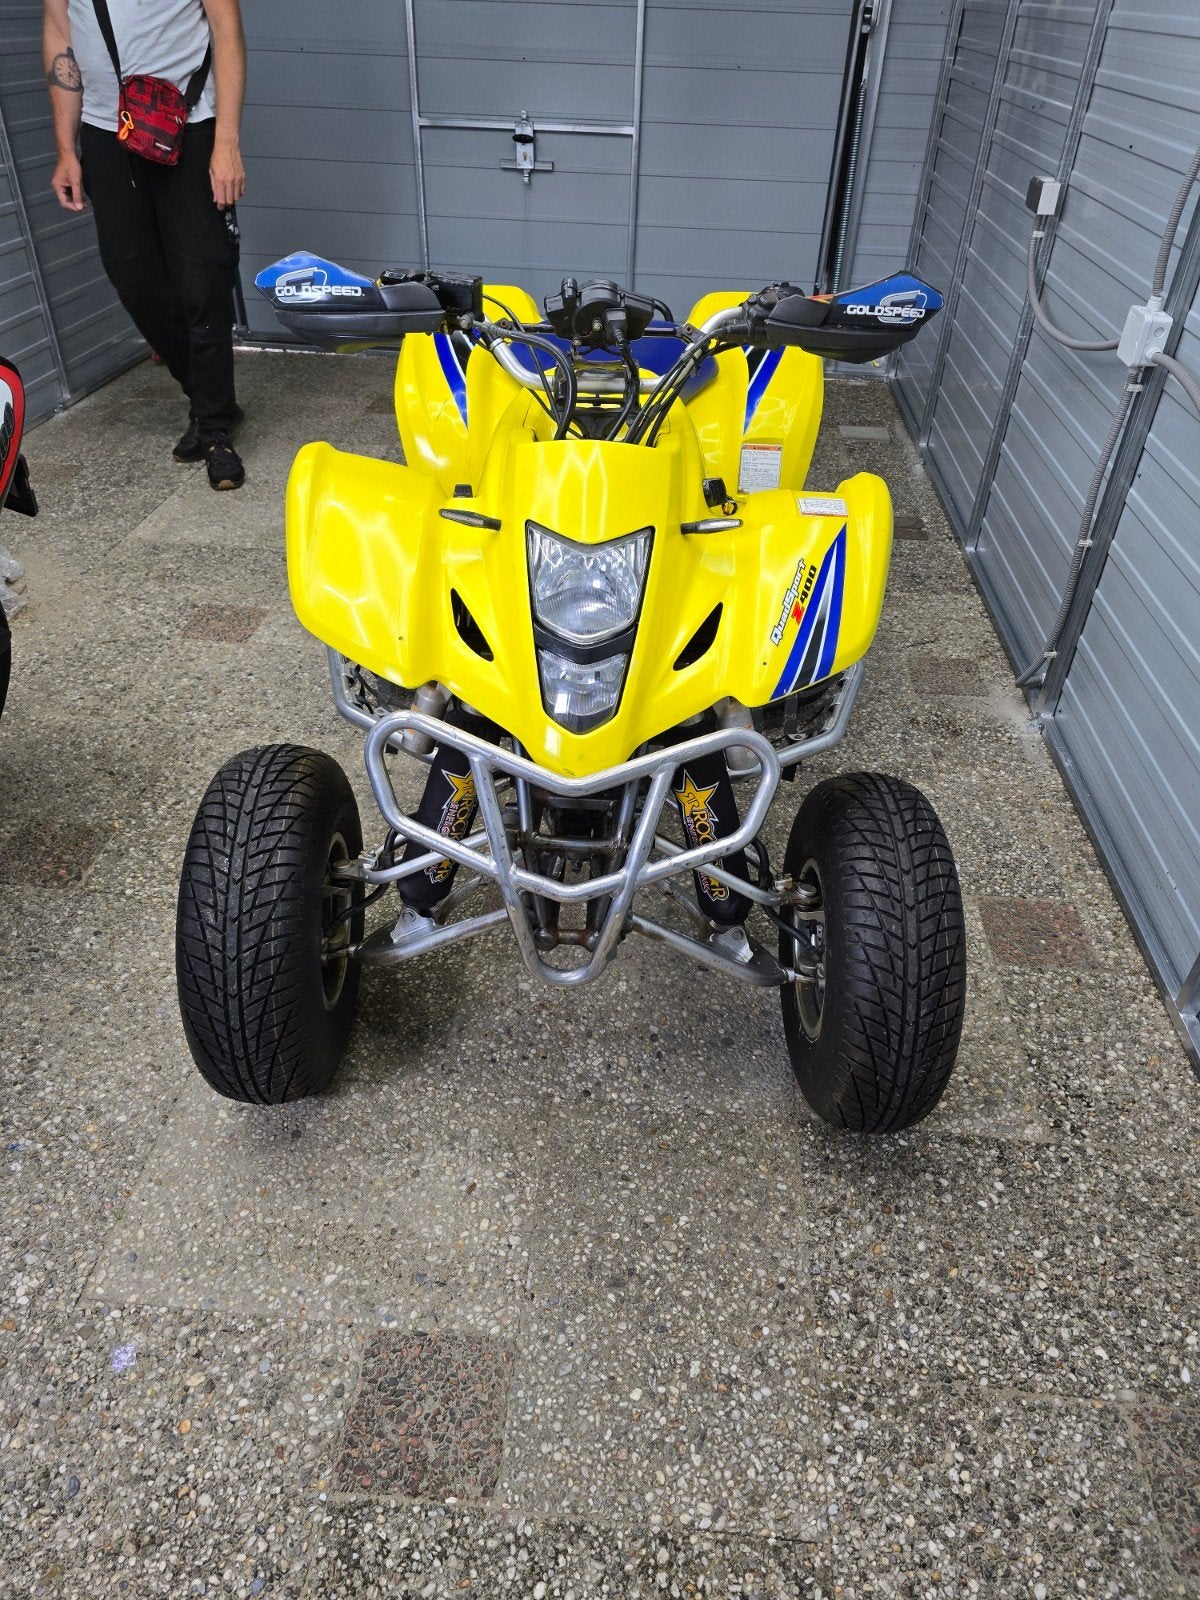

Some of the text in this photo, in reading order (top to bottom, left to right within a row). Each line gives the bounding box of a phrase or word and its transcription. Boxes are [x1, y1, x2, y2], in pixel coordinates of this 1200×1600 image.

[275, 285, 362, 297] GOLDSPEED
[846, 304, 926, 318] GOLDSPEED
[770, 557, 806, 647] QuadSport
[790, 564, 817, 626] Z400
[441, 801, 459, 837] ENERG
